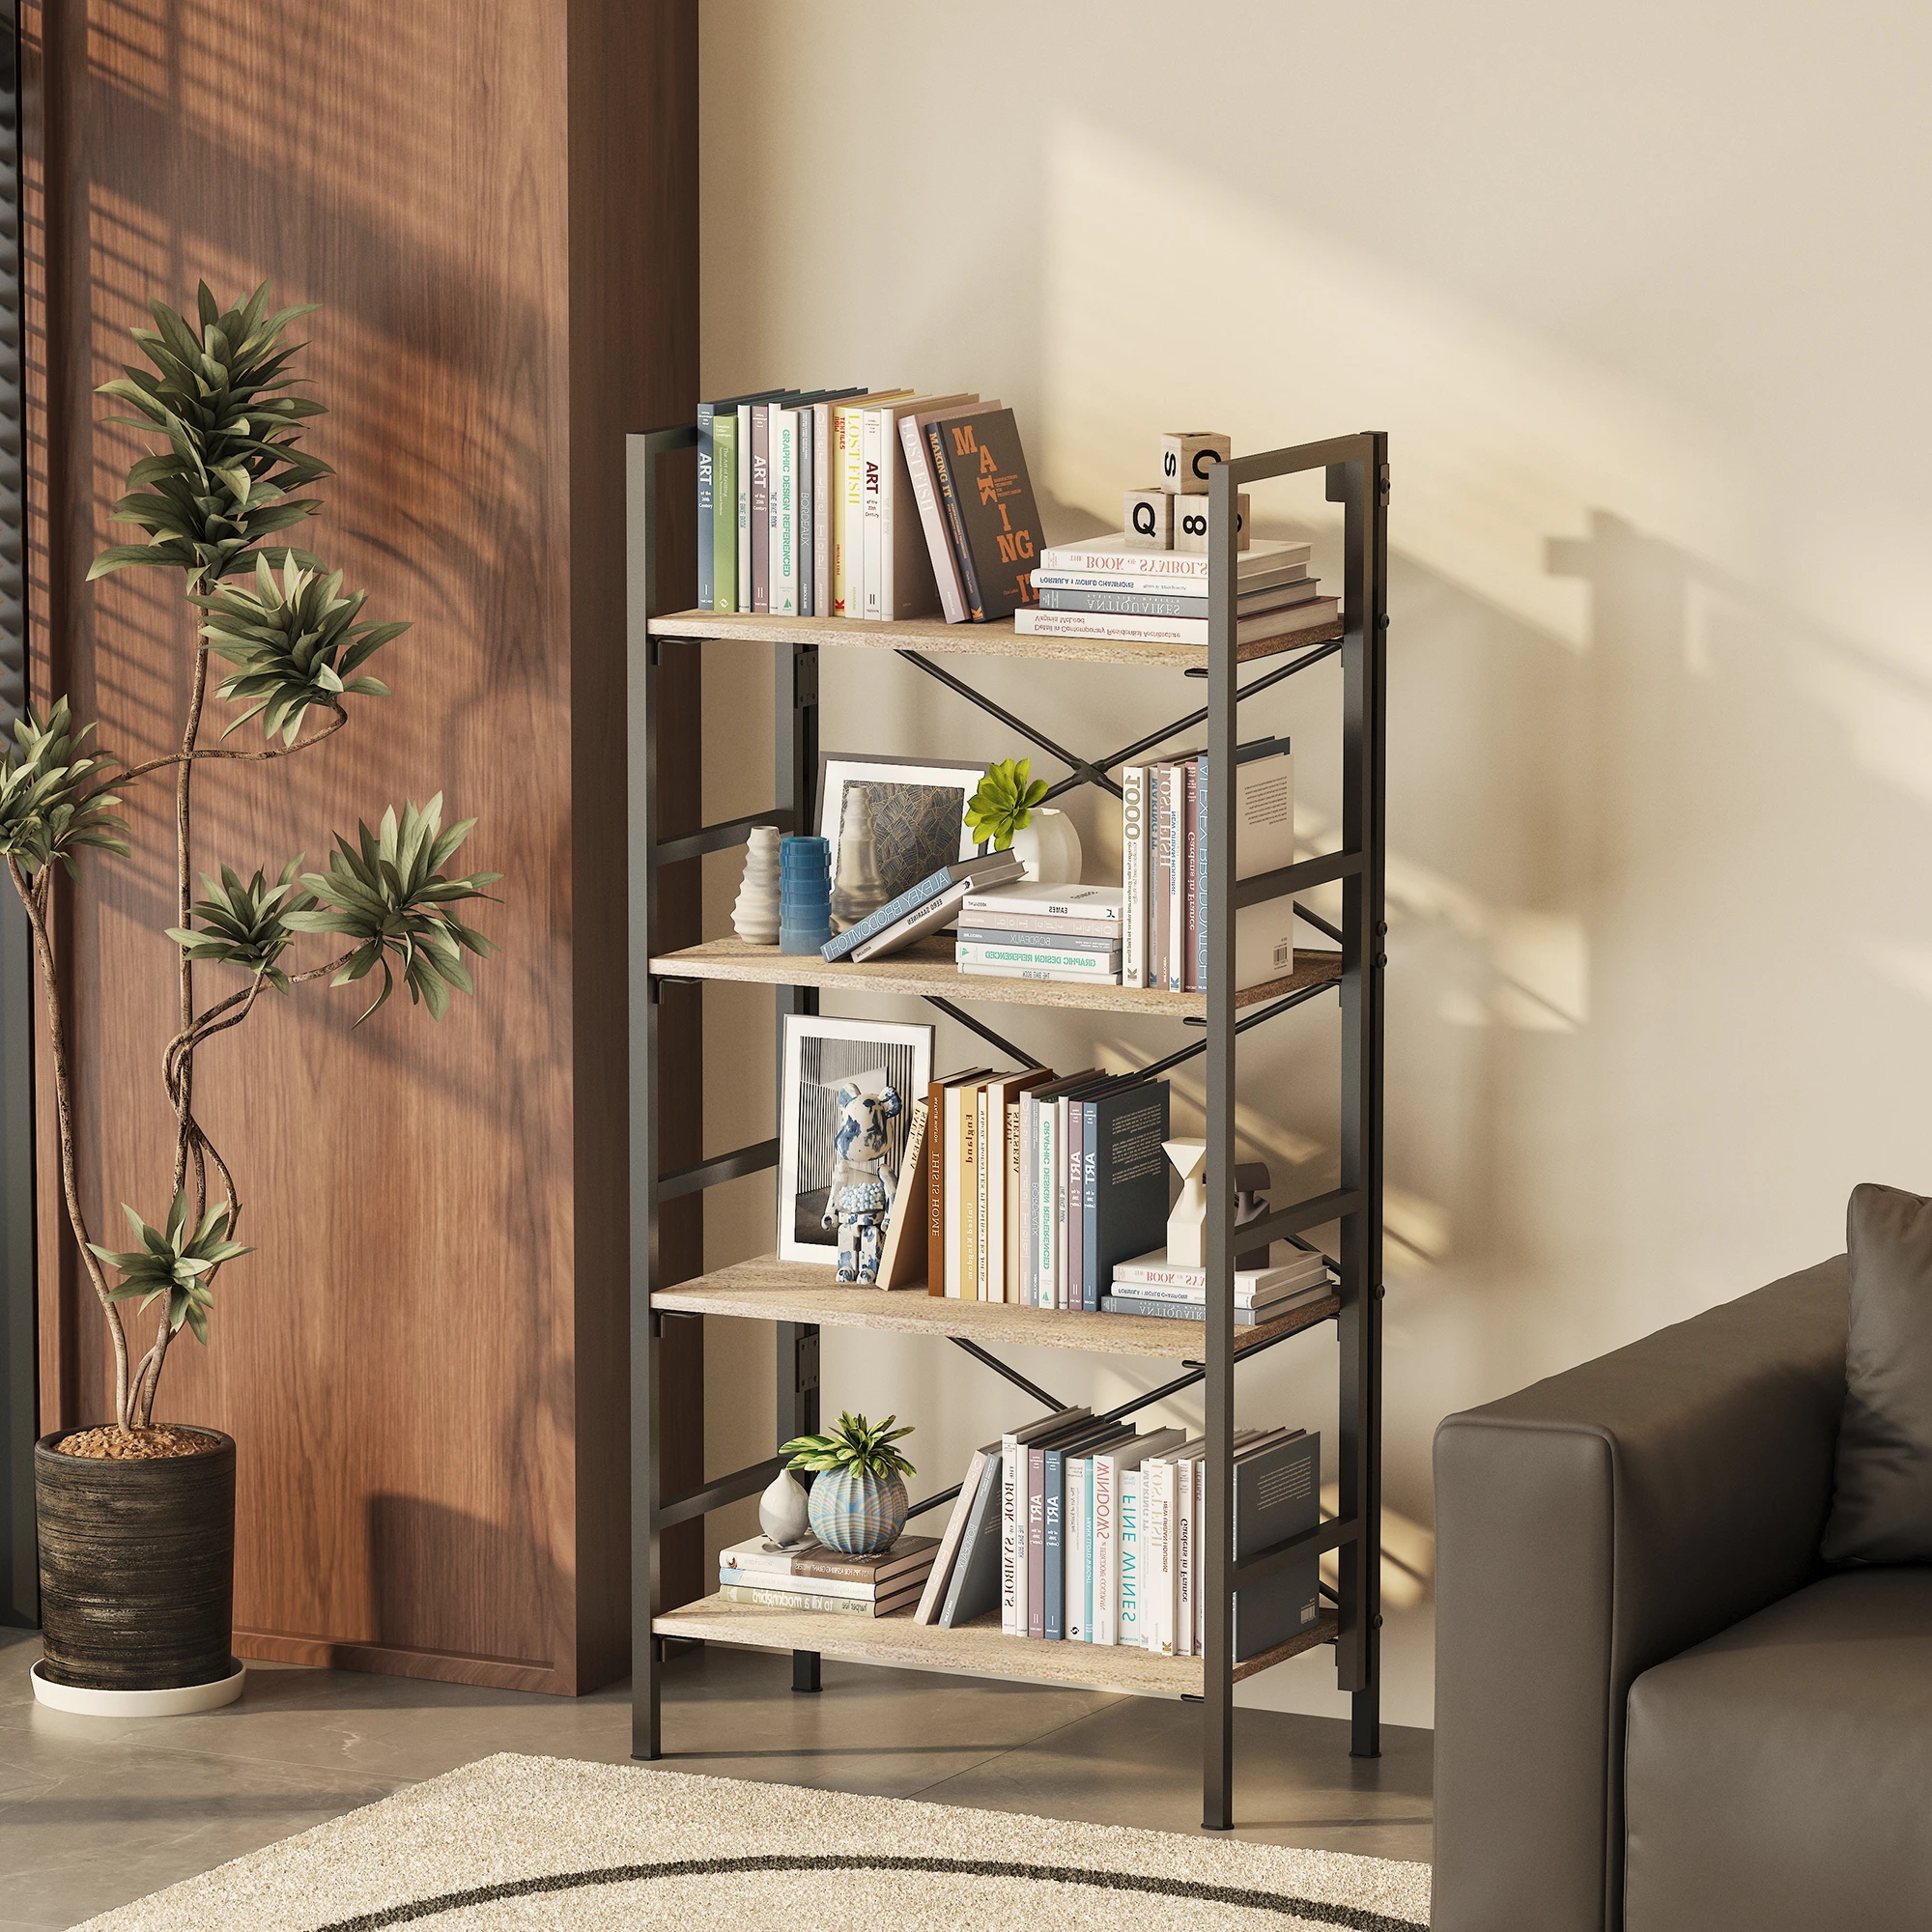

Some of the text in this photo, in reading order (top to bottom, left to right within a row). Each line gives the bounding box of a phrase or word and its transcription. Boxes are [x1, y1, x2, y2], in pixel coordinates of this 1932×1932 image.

[699, 452, 712, 485] ART
[753, 455, 766, 488] ART
[848, 415, 860, 503] LOST FISH
[900, 420, 935, 512] LOST FISH
[928, 432, 952, 497] MAKING IT
[866, 462, 878, 494] ART
[1132, 501, 1156, 538] Q
